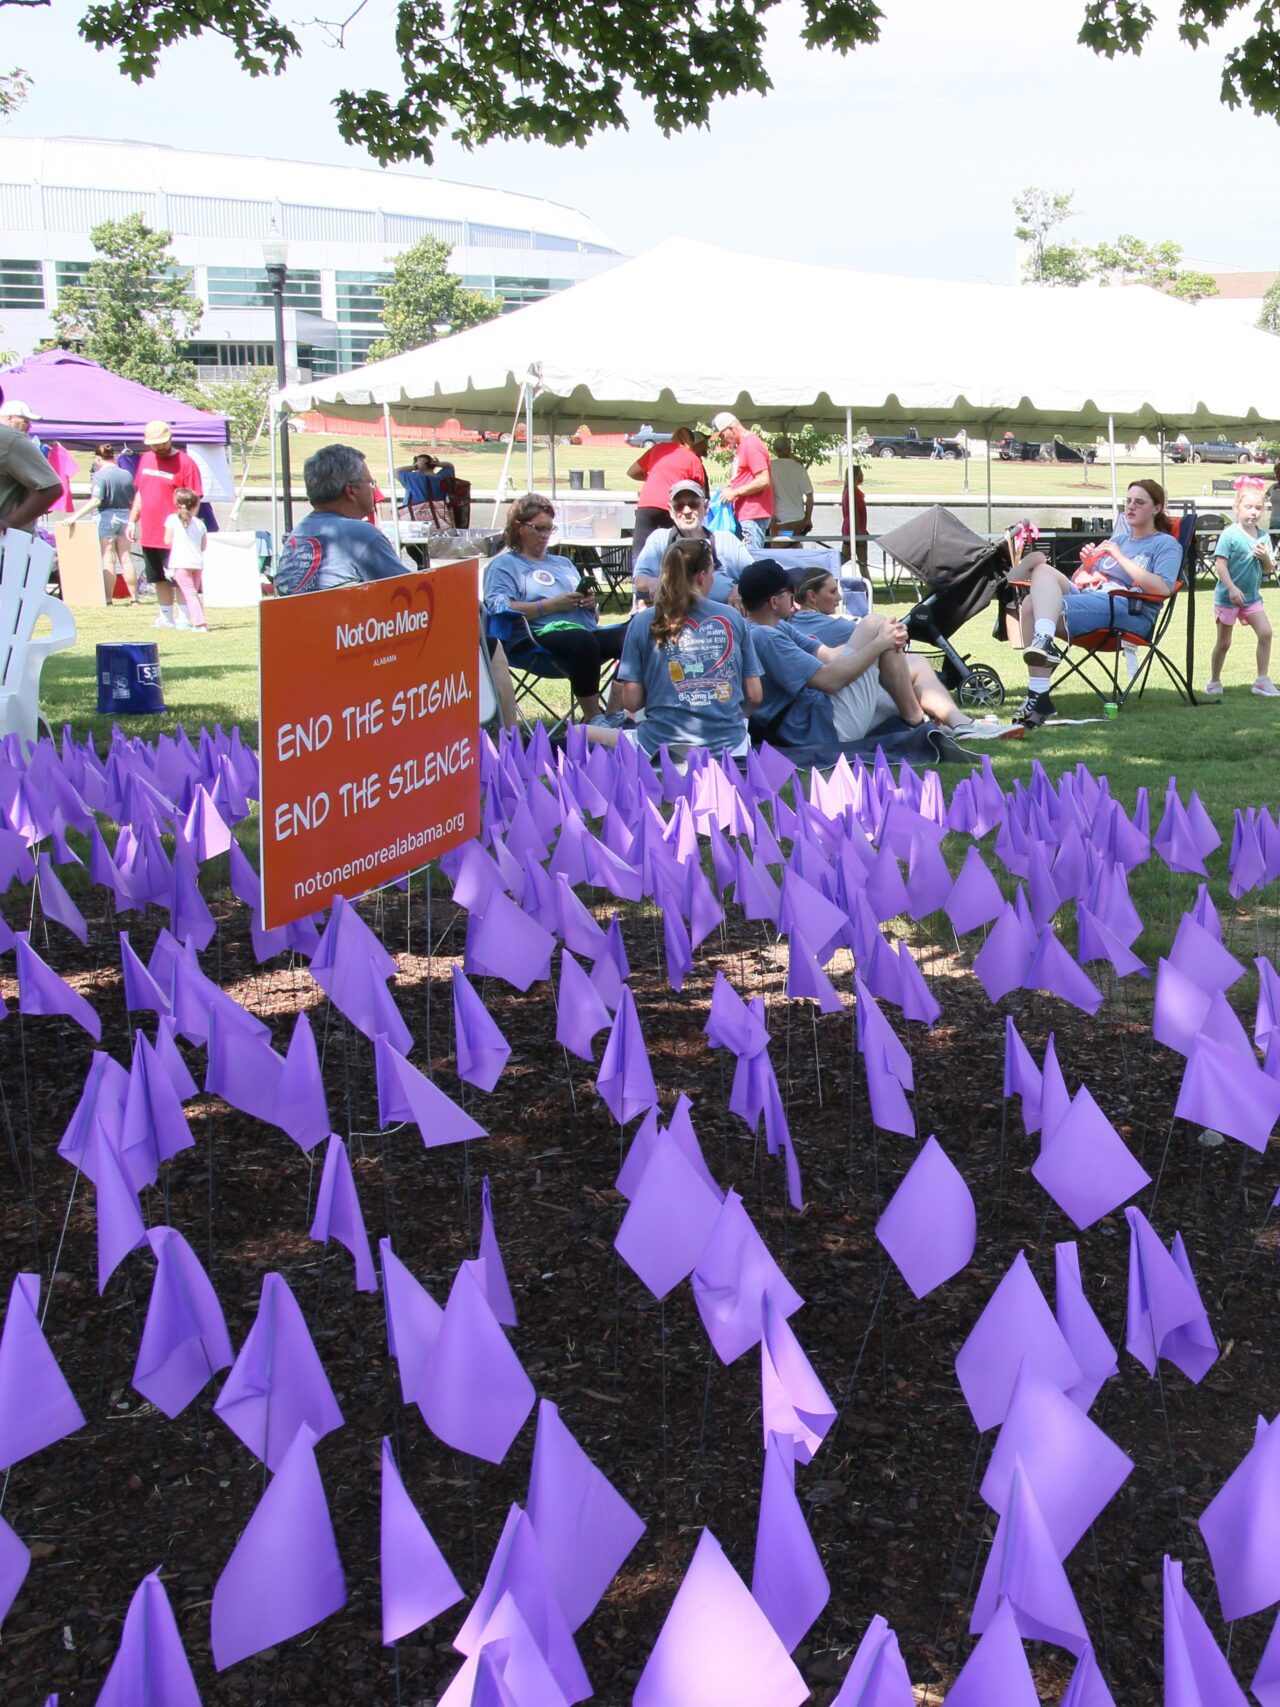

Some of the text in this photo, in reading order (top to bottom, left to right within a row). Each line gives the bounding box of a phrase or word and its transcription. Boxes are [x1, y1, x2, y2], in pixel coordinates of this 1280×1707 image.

[336, 624, 364, 650] Not
[365, 616, 396, 644] One
[395, 609, 428, 637] More
[373, 654, 397, 668] ALABAMA
[277, 670, 473, 762] END THE STIGMA.
[275, 737, 475, 843] END THE SILENCE.
[294, 811, 466, 900] notonemorealabama.org
